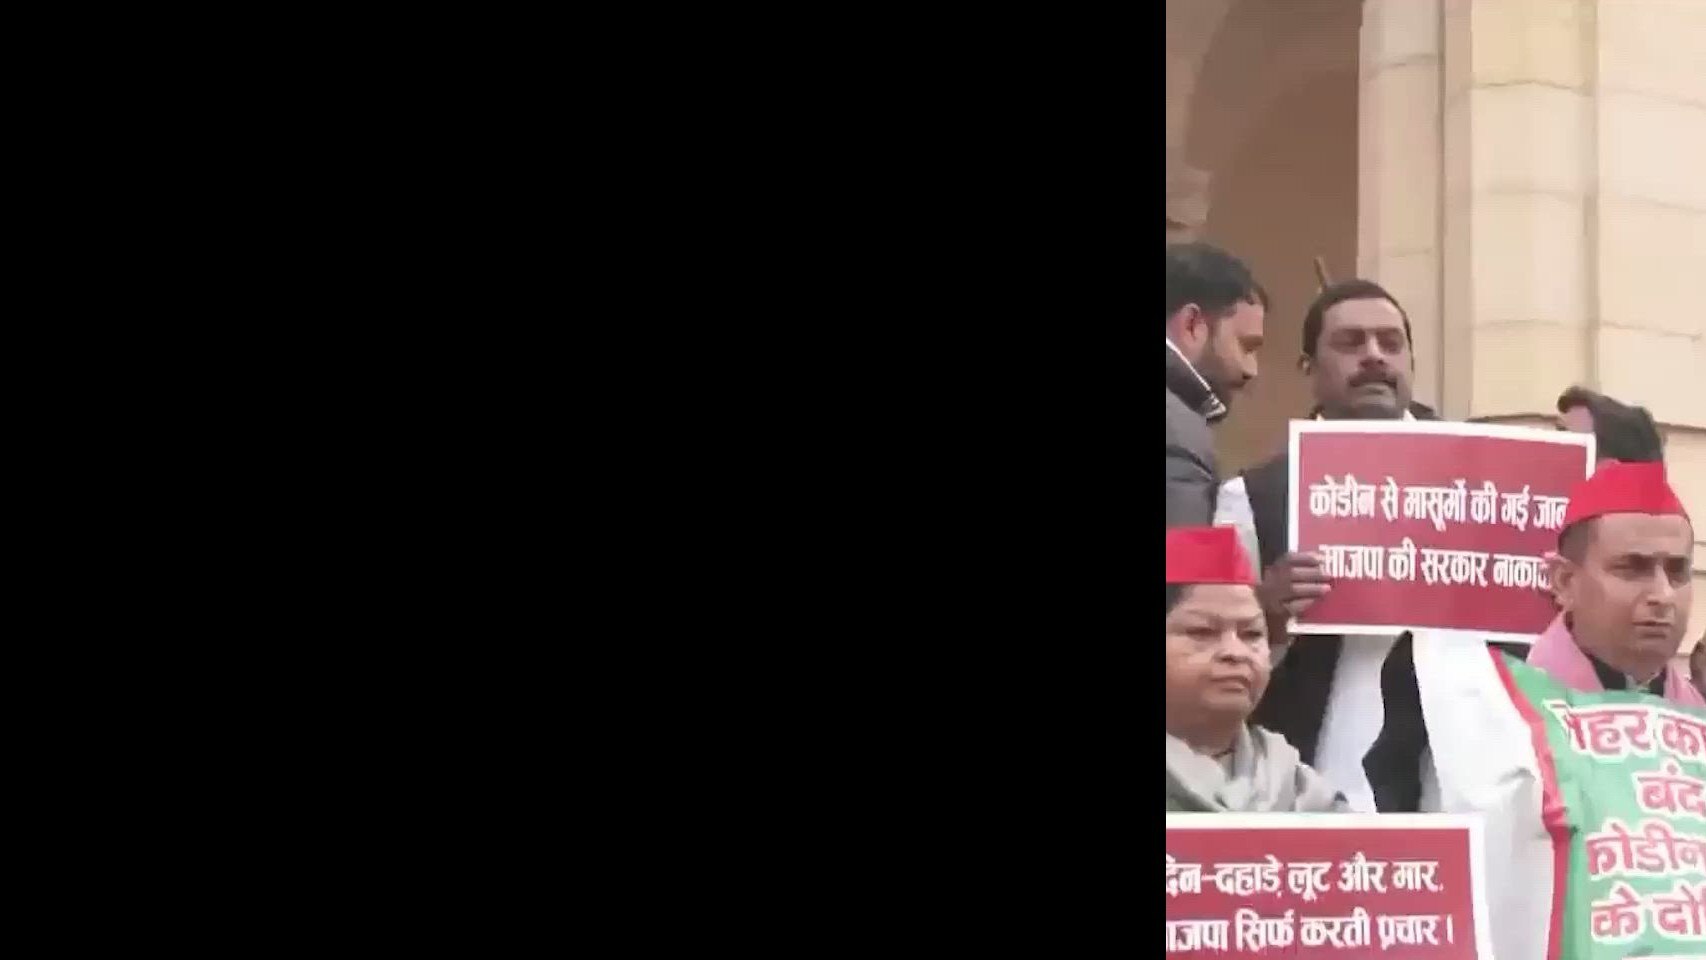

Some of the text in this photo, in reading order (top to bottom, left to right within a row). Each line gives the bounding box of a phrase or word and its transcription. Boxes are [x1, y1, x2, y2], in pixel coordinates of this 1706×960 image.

[1309, 473, 1376, 518] कोडीन
[1380, 476, 1398, 522] से
[1403, 478, 1467, 531] मासूमों
[1470, 480, 1498, 524] की
[1501, 484, 1530, 531] गई
[1388, 537, 1417, 581] की
[1420, 548, 1488, 587] सरकार
[1288, 862, 1332, 902] लूट
[1338, 851, 1388, 894] और
[1235, 907, 1294, 953] सिर्फ
[1300, 906, 1370, 948] करती
[1592, 886, 1640, 937] के
